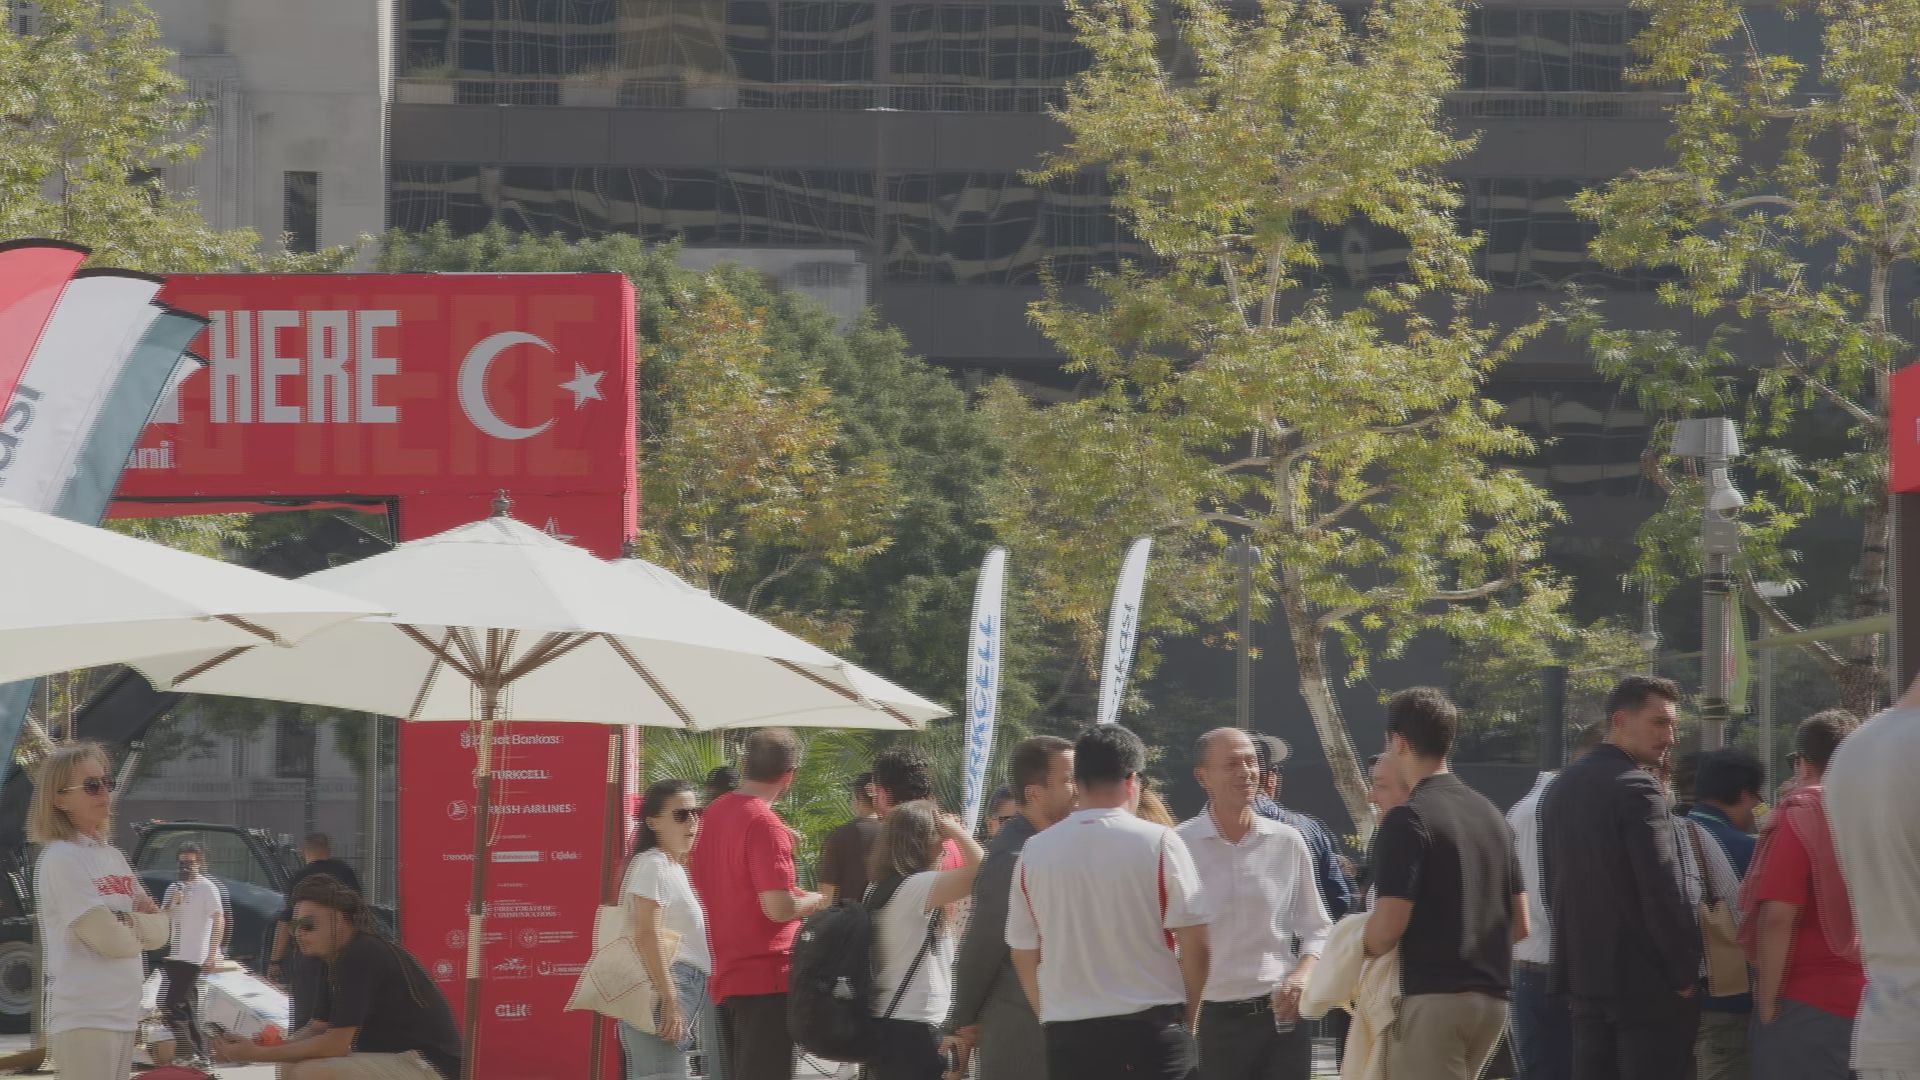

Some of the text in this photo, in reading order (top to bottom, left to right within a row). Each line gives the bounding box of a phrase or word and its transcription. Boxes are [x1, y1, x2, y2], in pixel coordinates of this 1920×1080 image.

[208, 309, 401, 424] HERE
[472, 733, 511, 746] Zaat
[490, 769, 550, 781] TURKCELL
[472, 803, 573, 815] TRKISH AIRLINES
[495, 1003, 528, 1018] CLK
